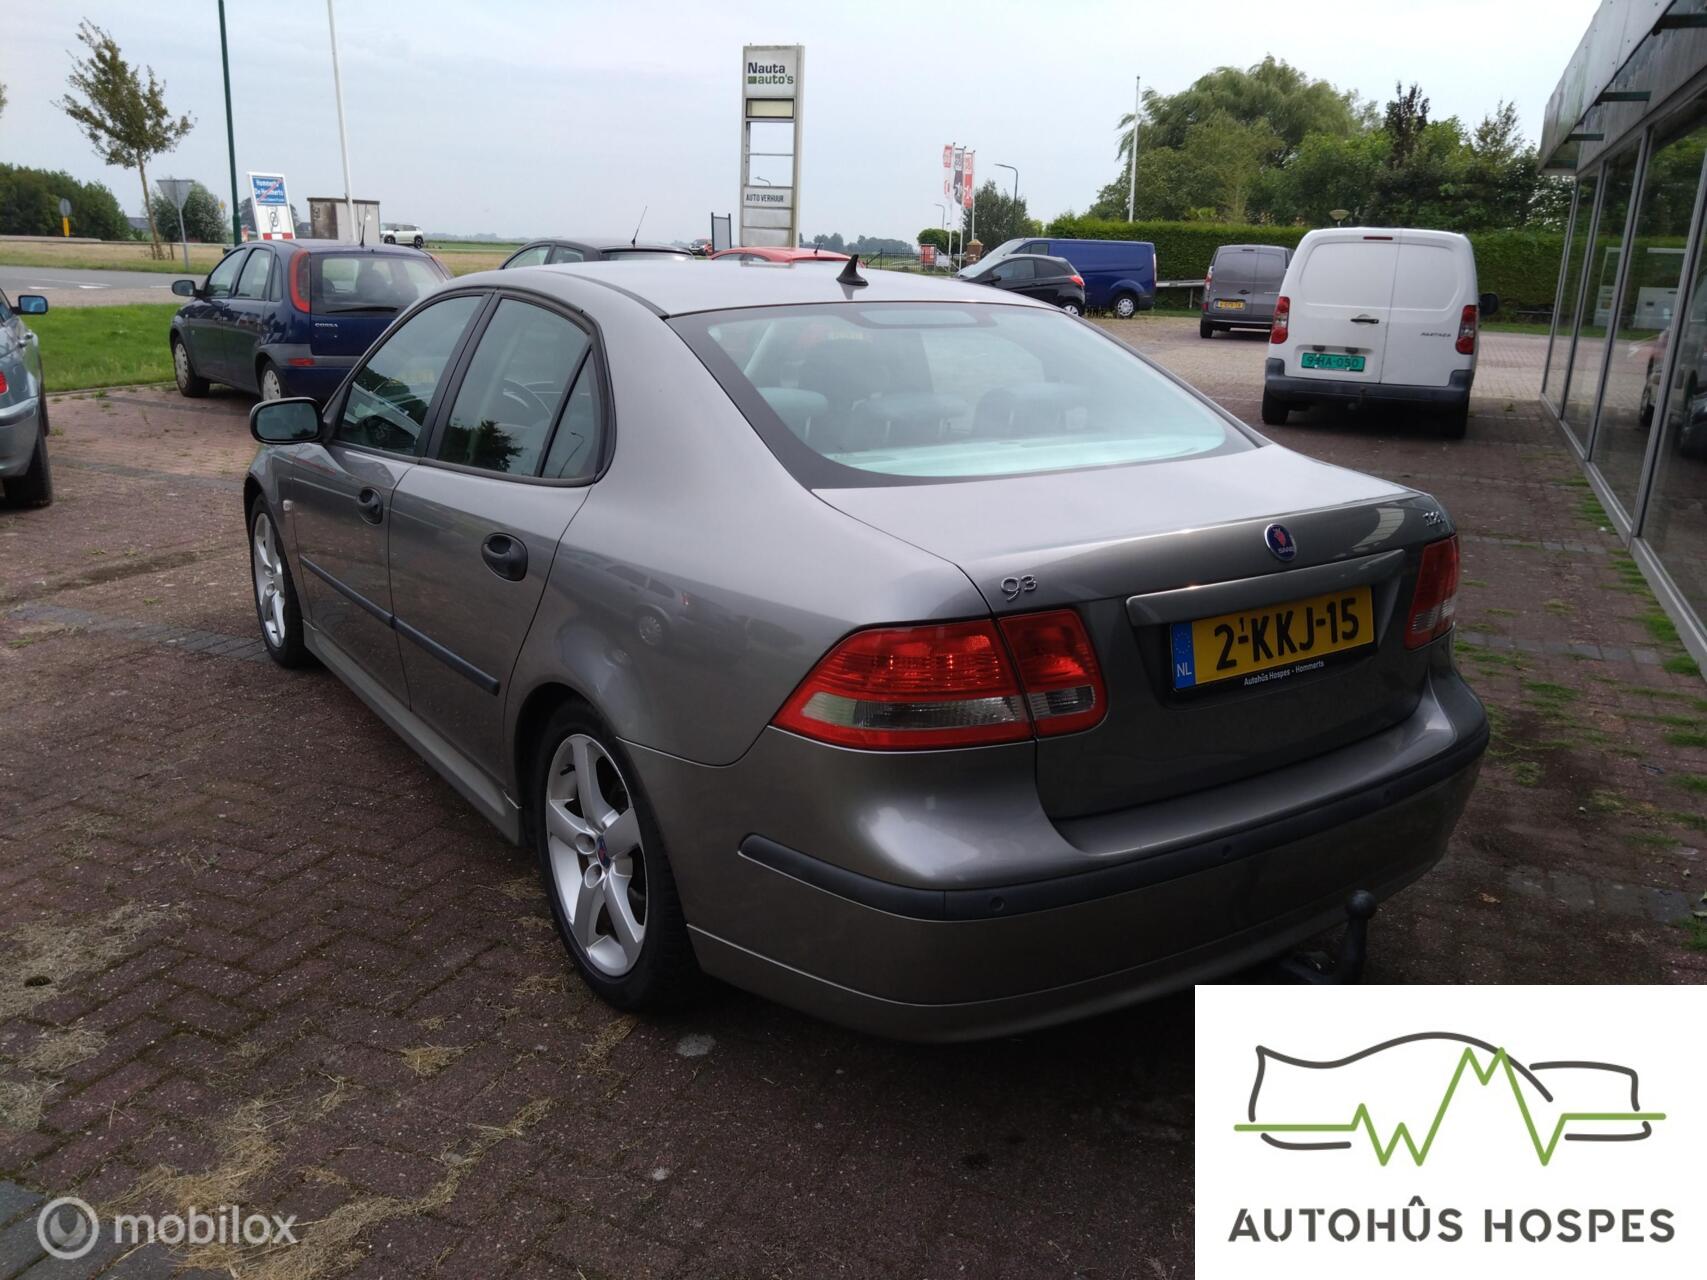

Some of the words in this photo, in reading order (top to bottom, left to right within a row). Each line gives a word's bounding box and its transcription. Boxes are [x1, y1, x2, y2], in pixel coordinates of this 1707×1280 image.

[747, 62, 786, 74] Nauta
[757, 74, 794, 84] auto's
[746, 193, 760, 201] AUTO
[1176, 662, 1192, 678] NL
[1268, 665, 1291, 681] Hospes
[1295, 660, 1325, 674] Hommerts
